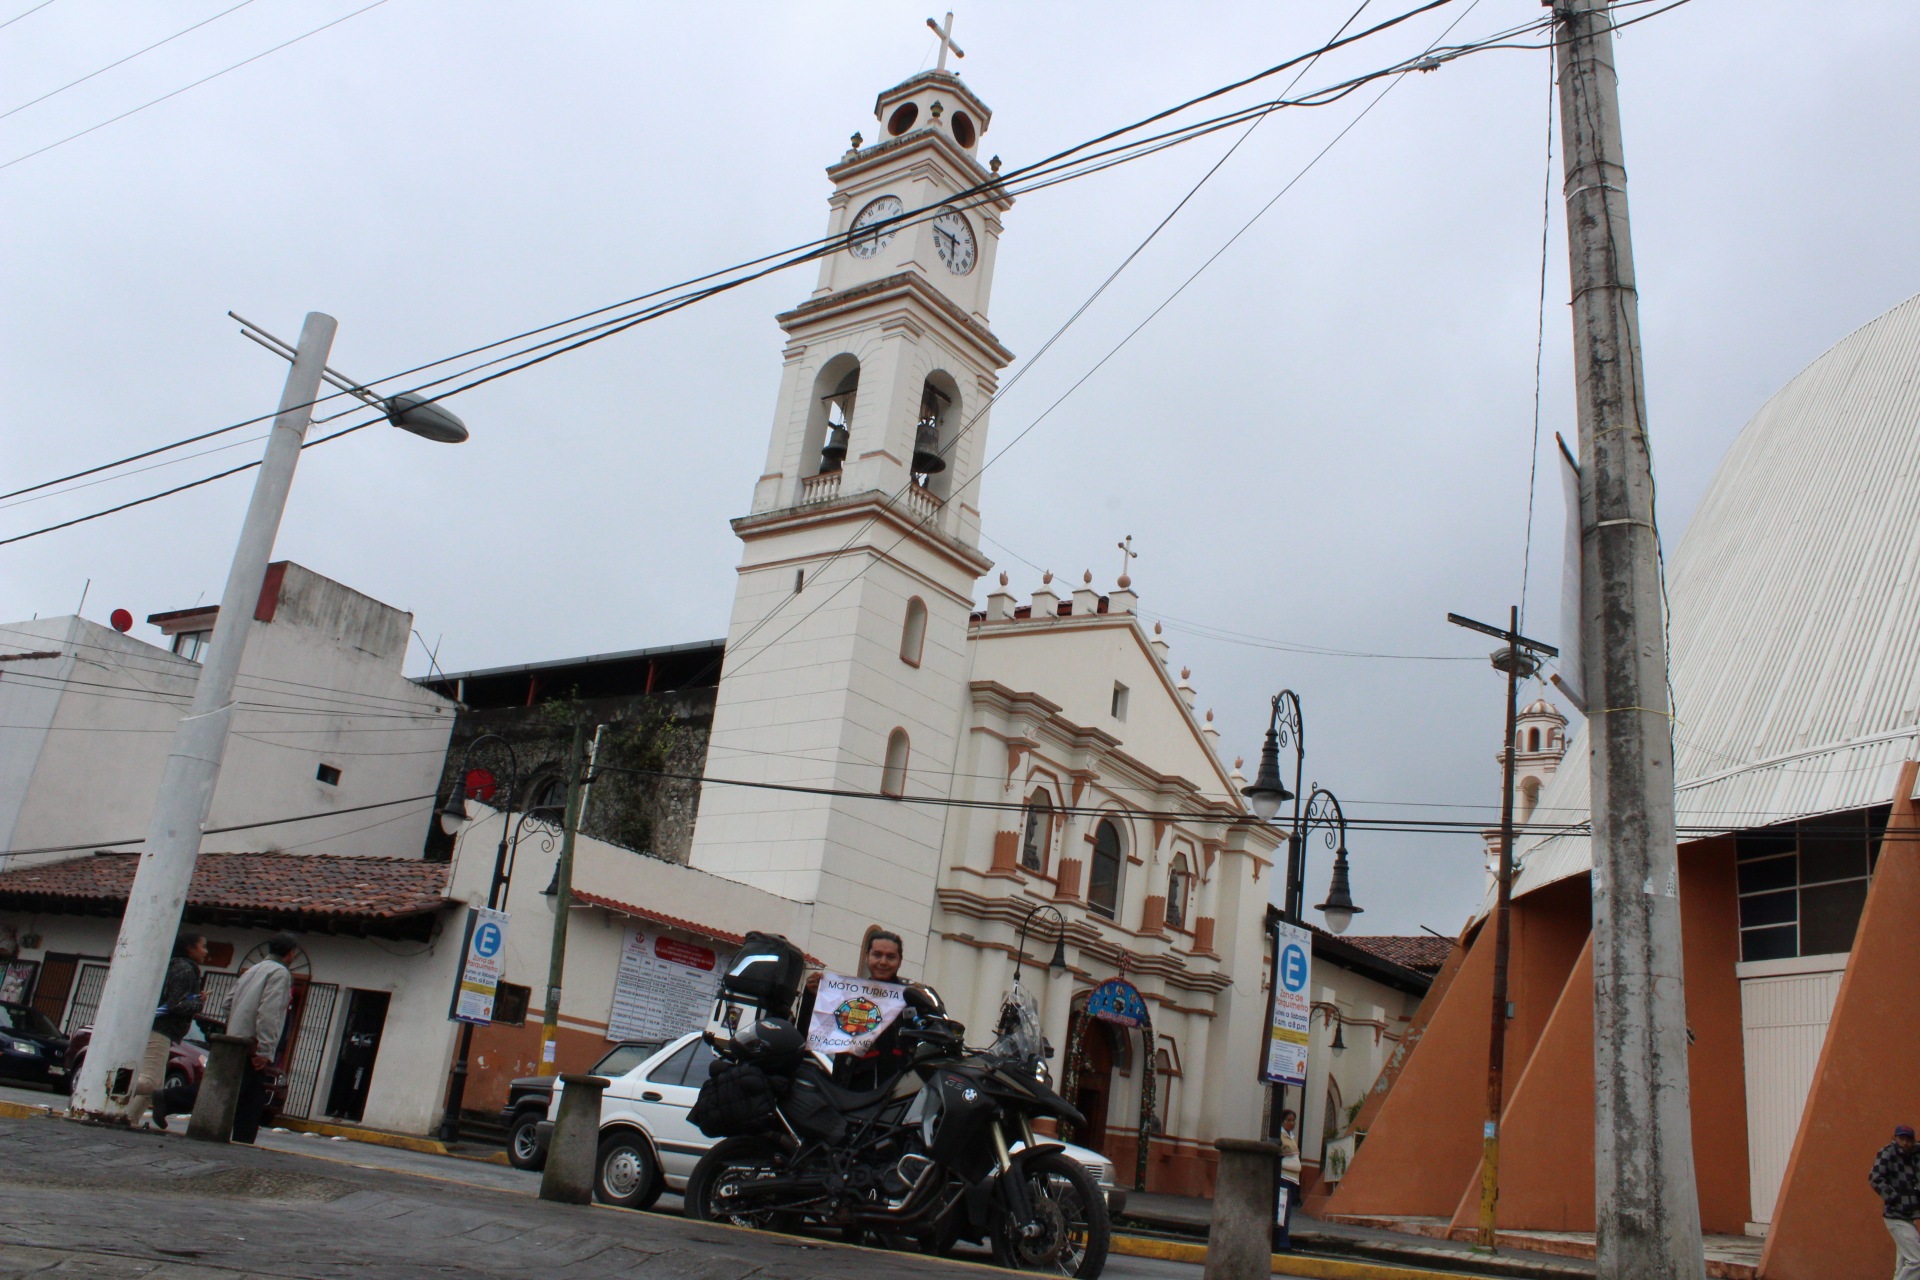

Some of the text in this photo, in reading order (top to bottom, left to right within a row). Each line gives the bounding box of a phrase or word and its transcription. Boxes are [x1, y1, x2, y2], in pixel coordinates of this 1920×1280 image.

[480, 926, 496, 954] E
[473, 954, 486, 963] Zona
[1286, 949, 1300, 987] E
[828, 981, 899, 999] MOTO TURISTA
[1280, 989, 1294, 1000] Zona
